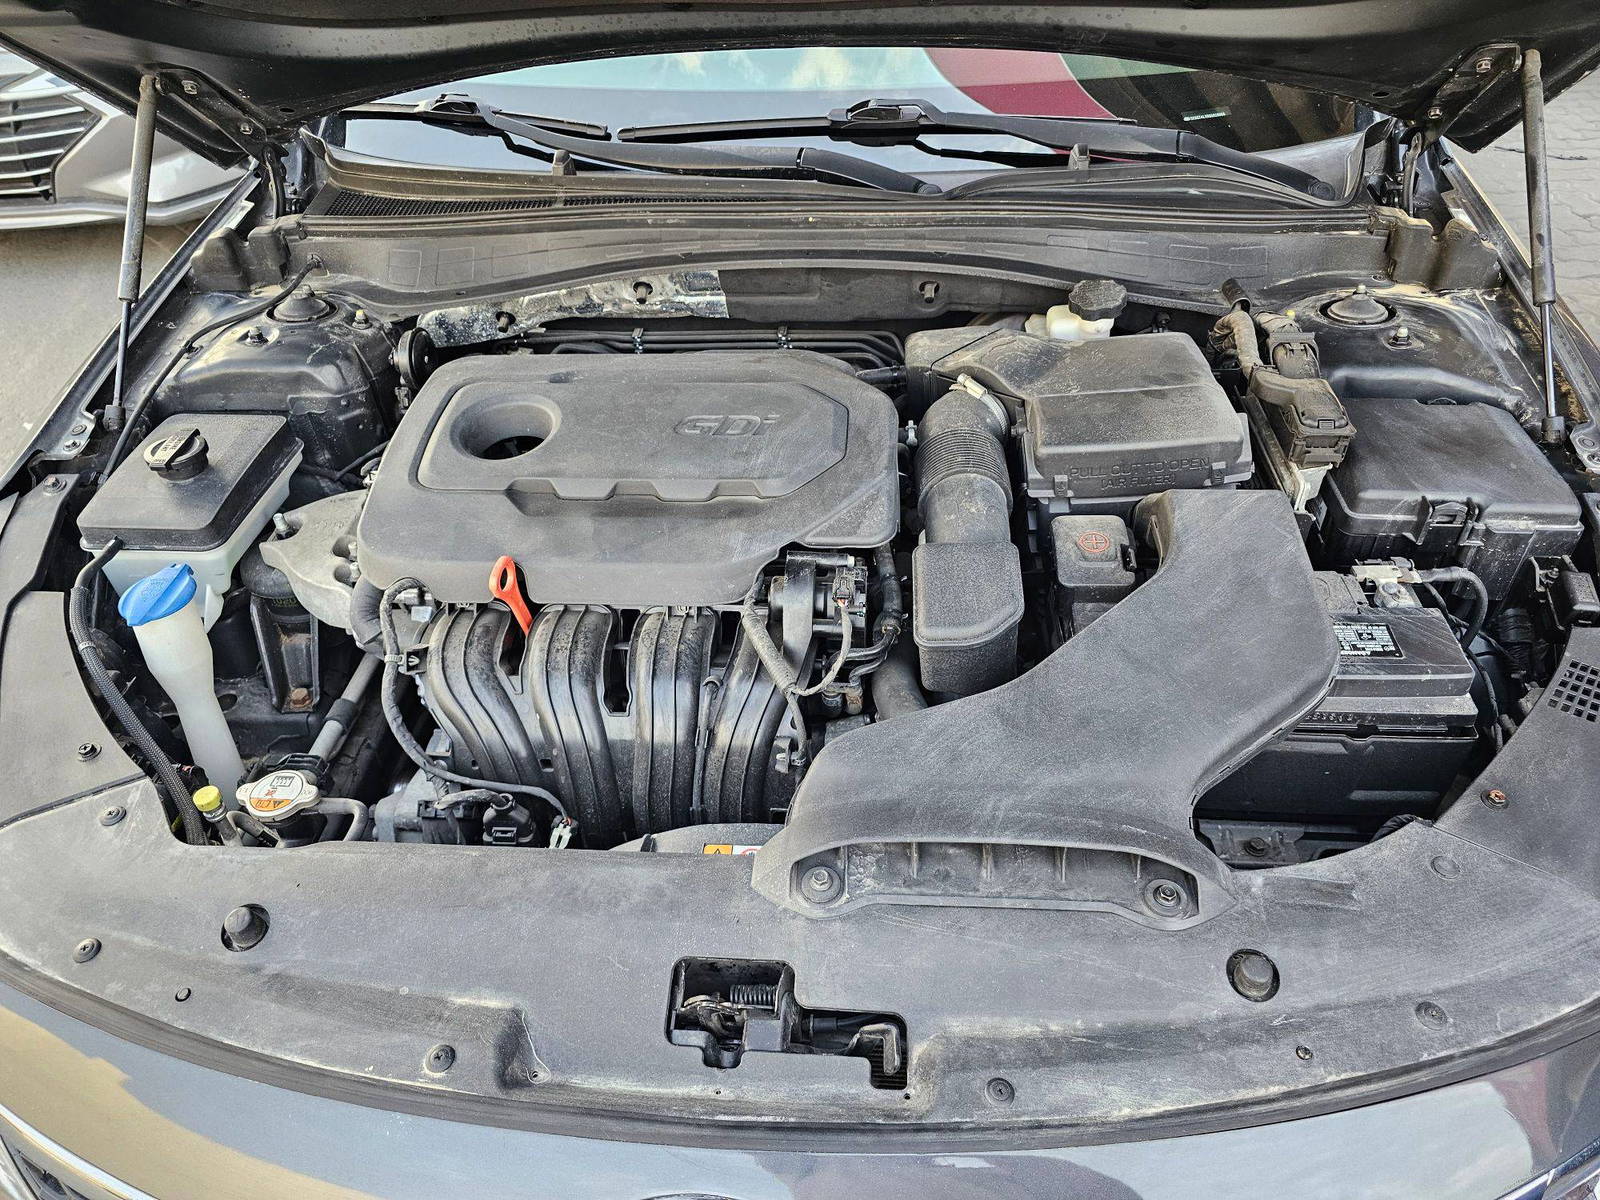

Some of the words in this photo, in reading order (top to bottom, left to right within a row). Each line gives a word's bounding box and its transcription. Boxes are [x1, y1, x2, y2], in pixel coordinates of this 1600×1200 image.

[673, 414, 780, 436] GDi
[1069, 466, 1107, 479] PULL
[1111, 464, 1142, 477] OUT
[1144, 462, 1164, 474] TO
[1169, 457, 1210, 472] OPEN
